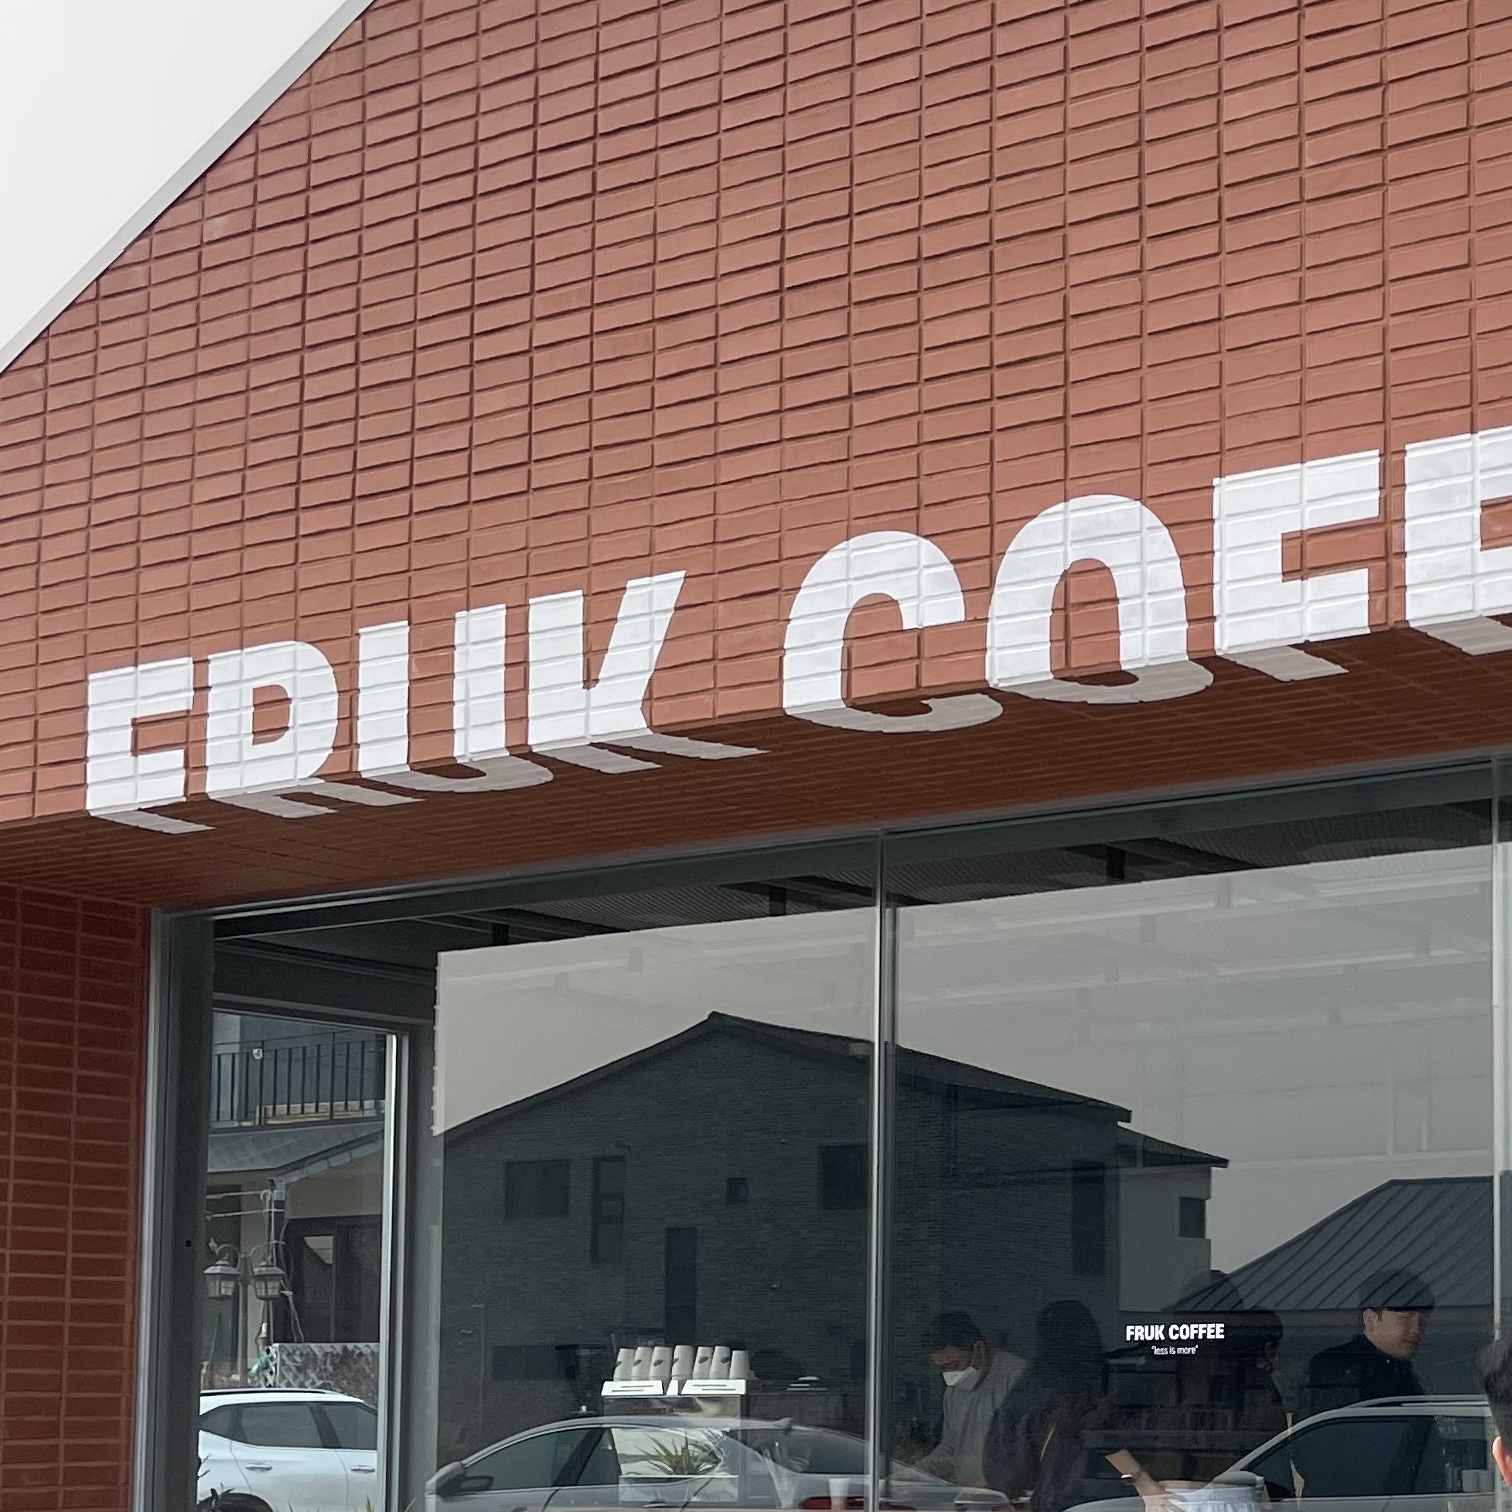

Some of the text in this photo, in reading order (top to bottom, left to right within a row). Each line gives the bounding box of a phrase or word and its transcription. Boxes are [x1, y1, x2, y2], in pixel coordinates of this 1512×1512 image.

[86, 570, 772, 835] FRUK
[1126, 1323, 1225, 1341] FRUK COFFEE
[1169, 1345, 1177, 1355] is
